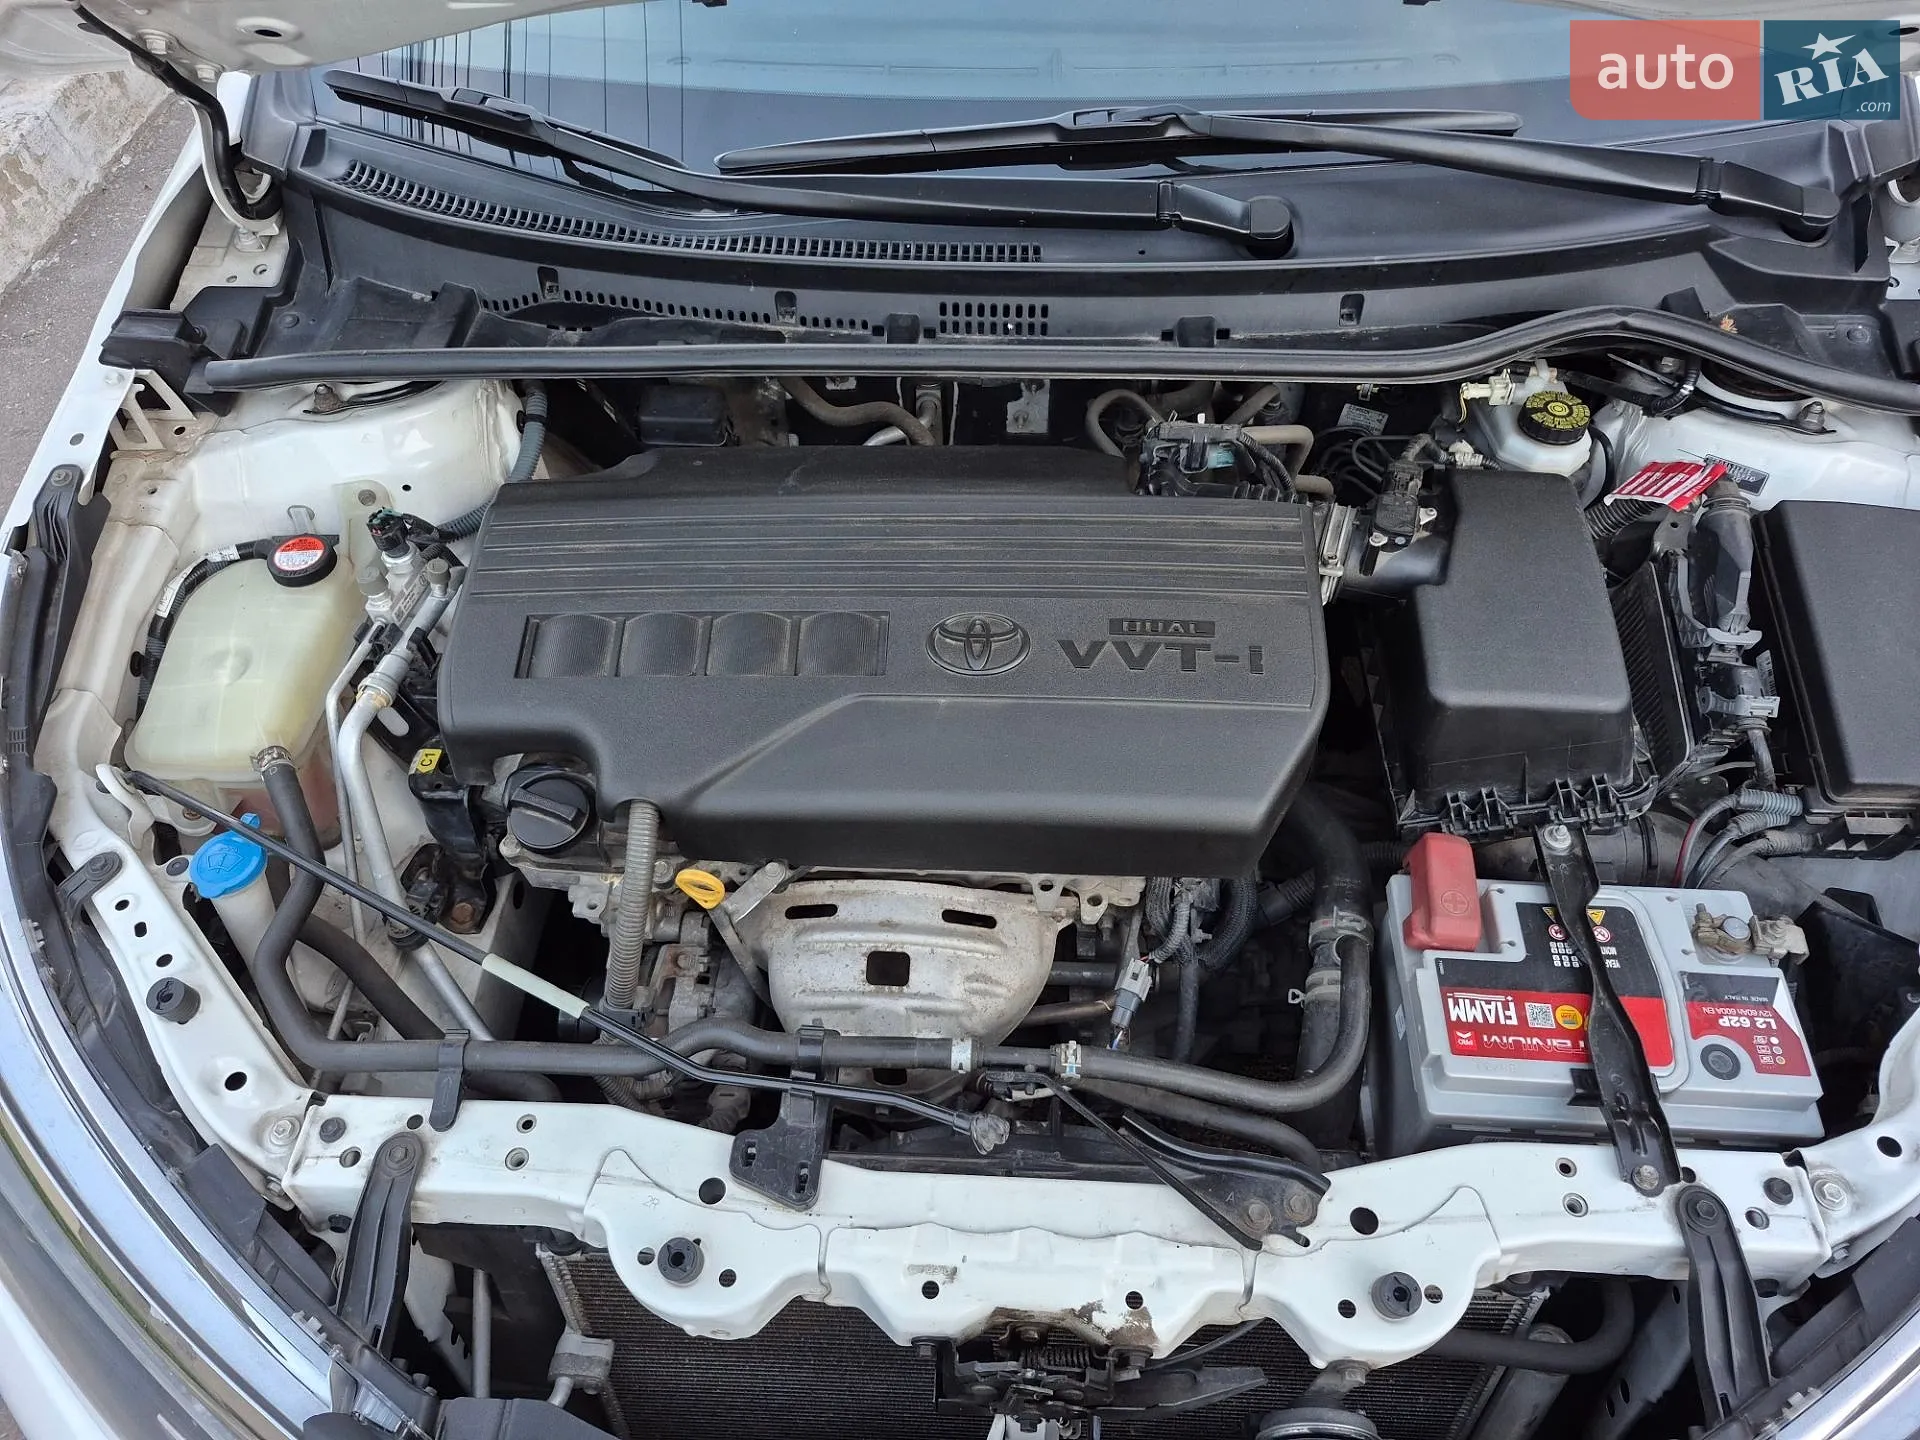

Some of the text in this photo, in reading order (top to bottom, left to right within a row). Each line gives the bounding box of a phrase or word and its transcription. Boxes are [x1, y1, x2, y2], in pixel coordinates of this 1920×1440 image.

[1122, 620, 1211, 635] DUAL
[420, 753, 435, 767] C1
[1448, 998, 1518, 1025] FIAMM
[1716, 1007, 1736, 1015] 600A
[1737, 1008, 1758, 1016] 60Ah
[1718, 1015, 1777, 1030] L2 62P
[1457, 1038, 1473, 1047] PRO
